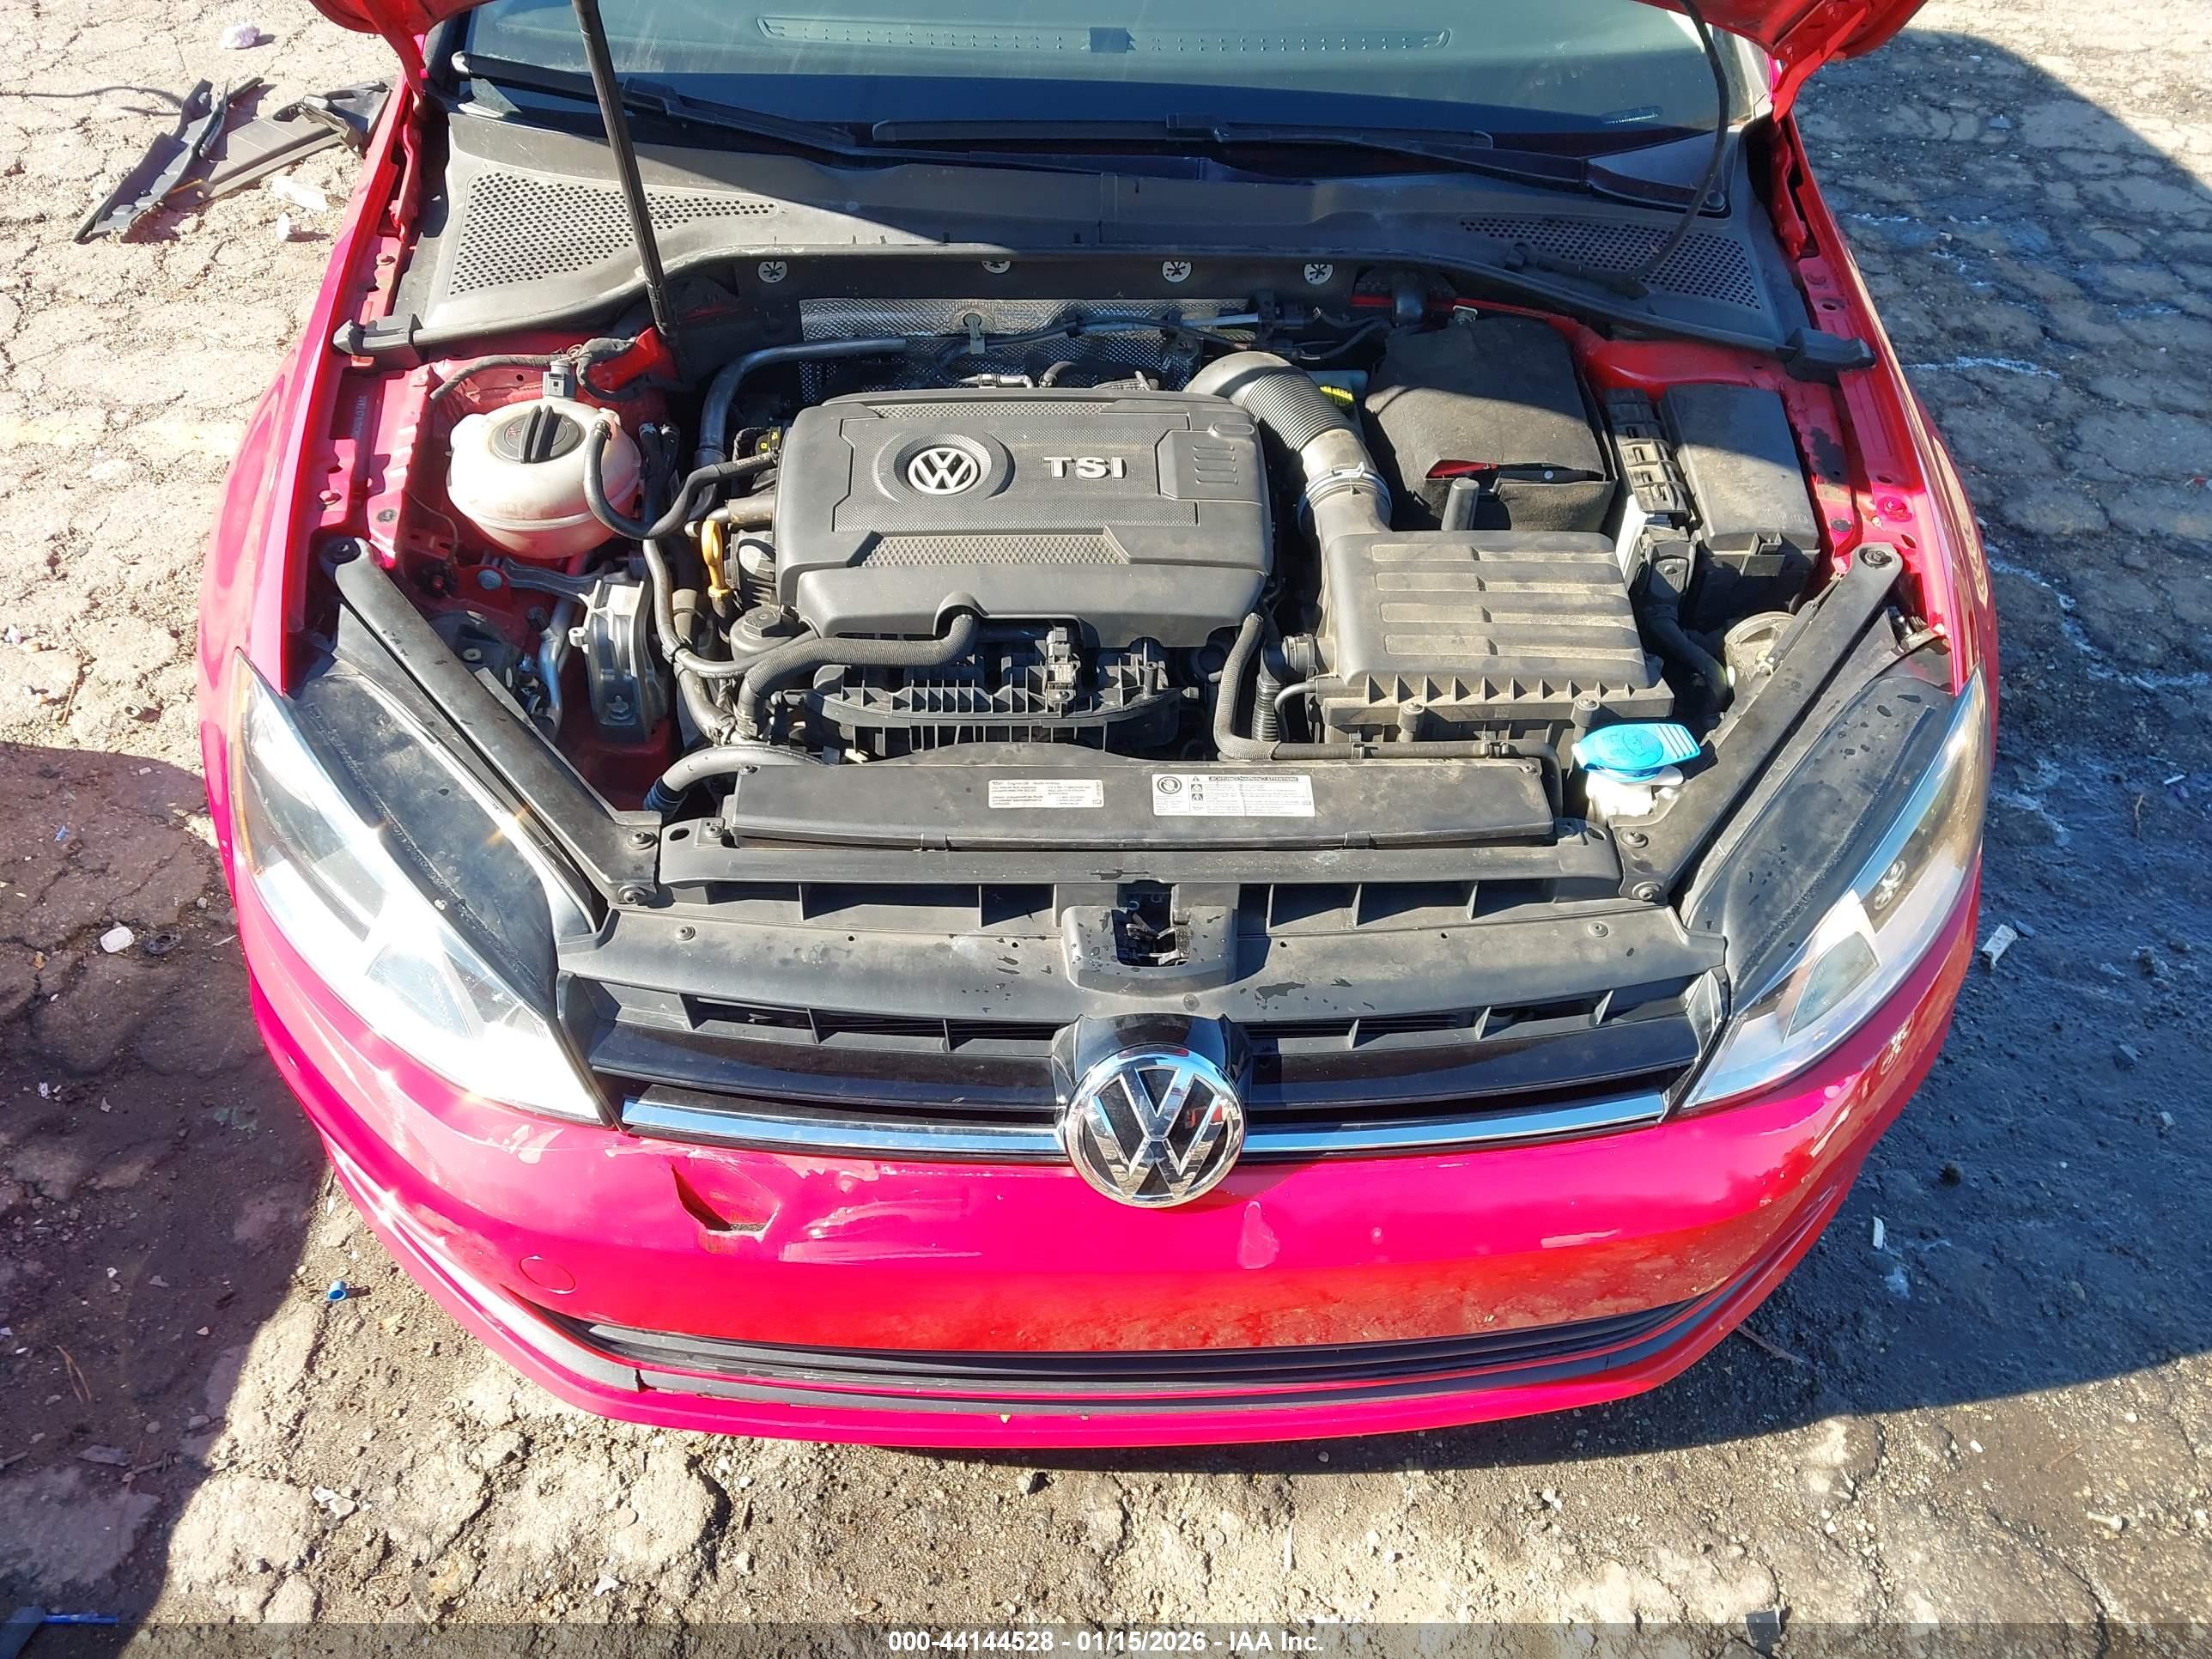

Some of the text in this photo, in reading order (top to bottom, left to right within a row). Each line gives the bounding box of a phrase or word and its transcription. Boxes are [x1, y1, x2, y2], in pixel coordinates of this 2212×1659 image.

[908, 447, 977, 495] VW
[1042, 457, 1127, 479] TSI
[1064, 1043, 1245, 1208] VW
